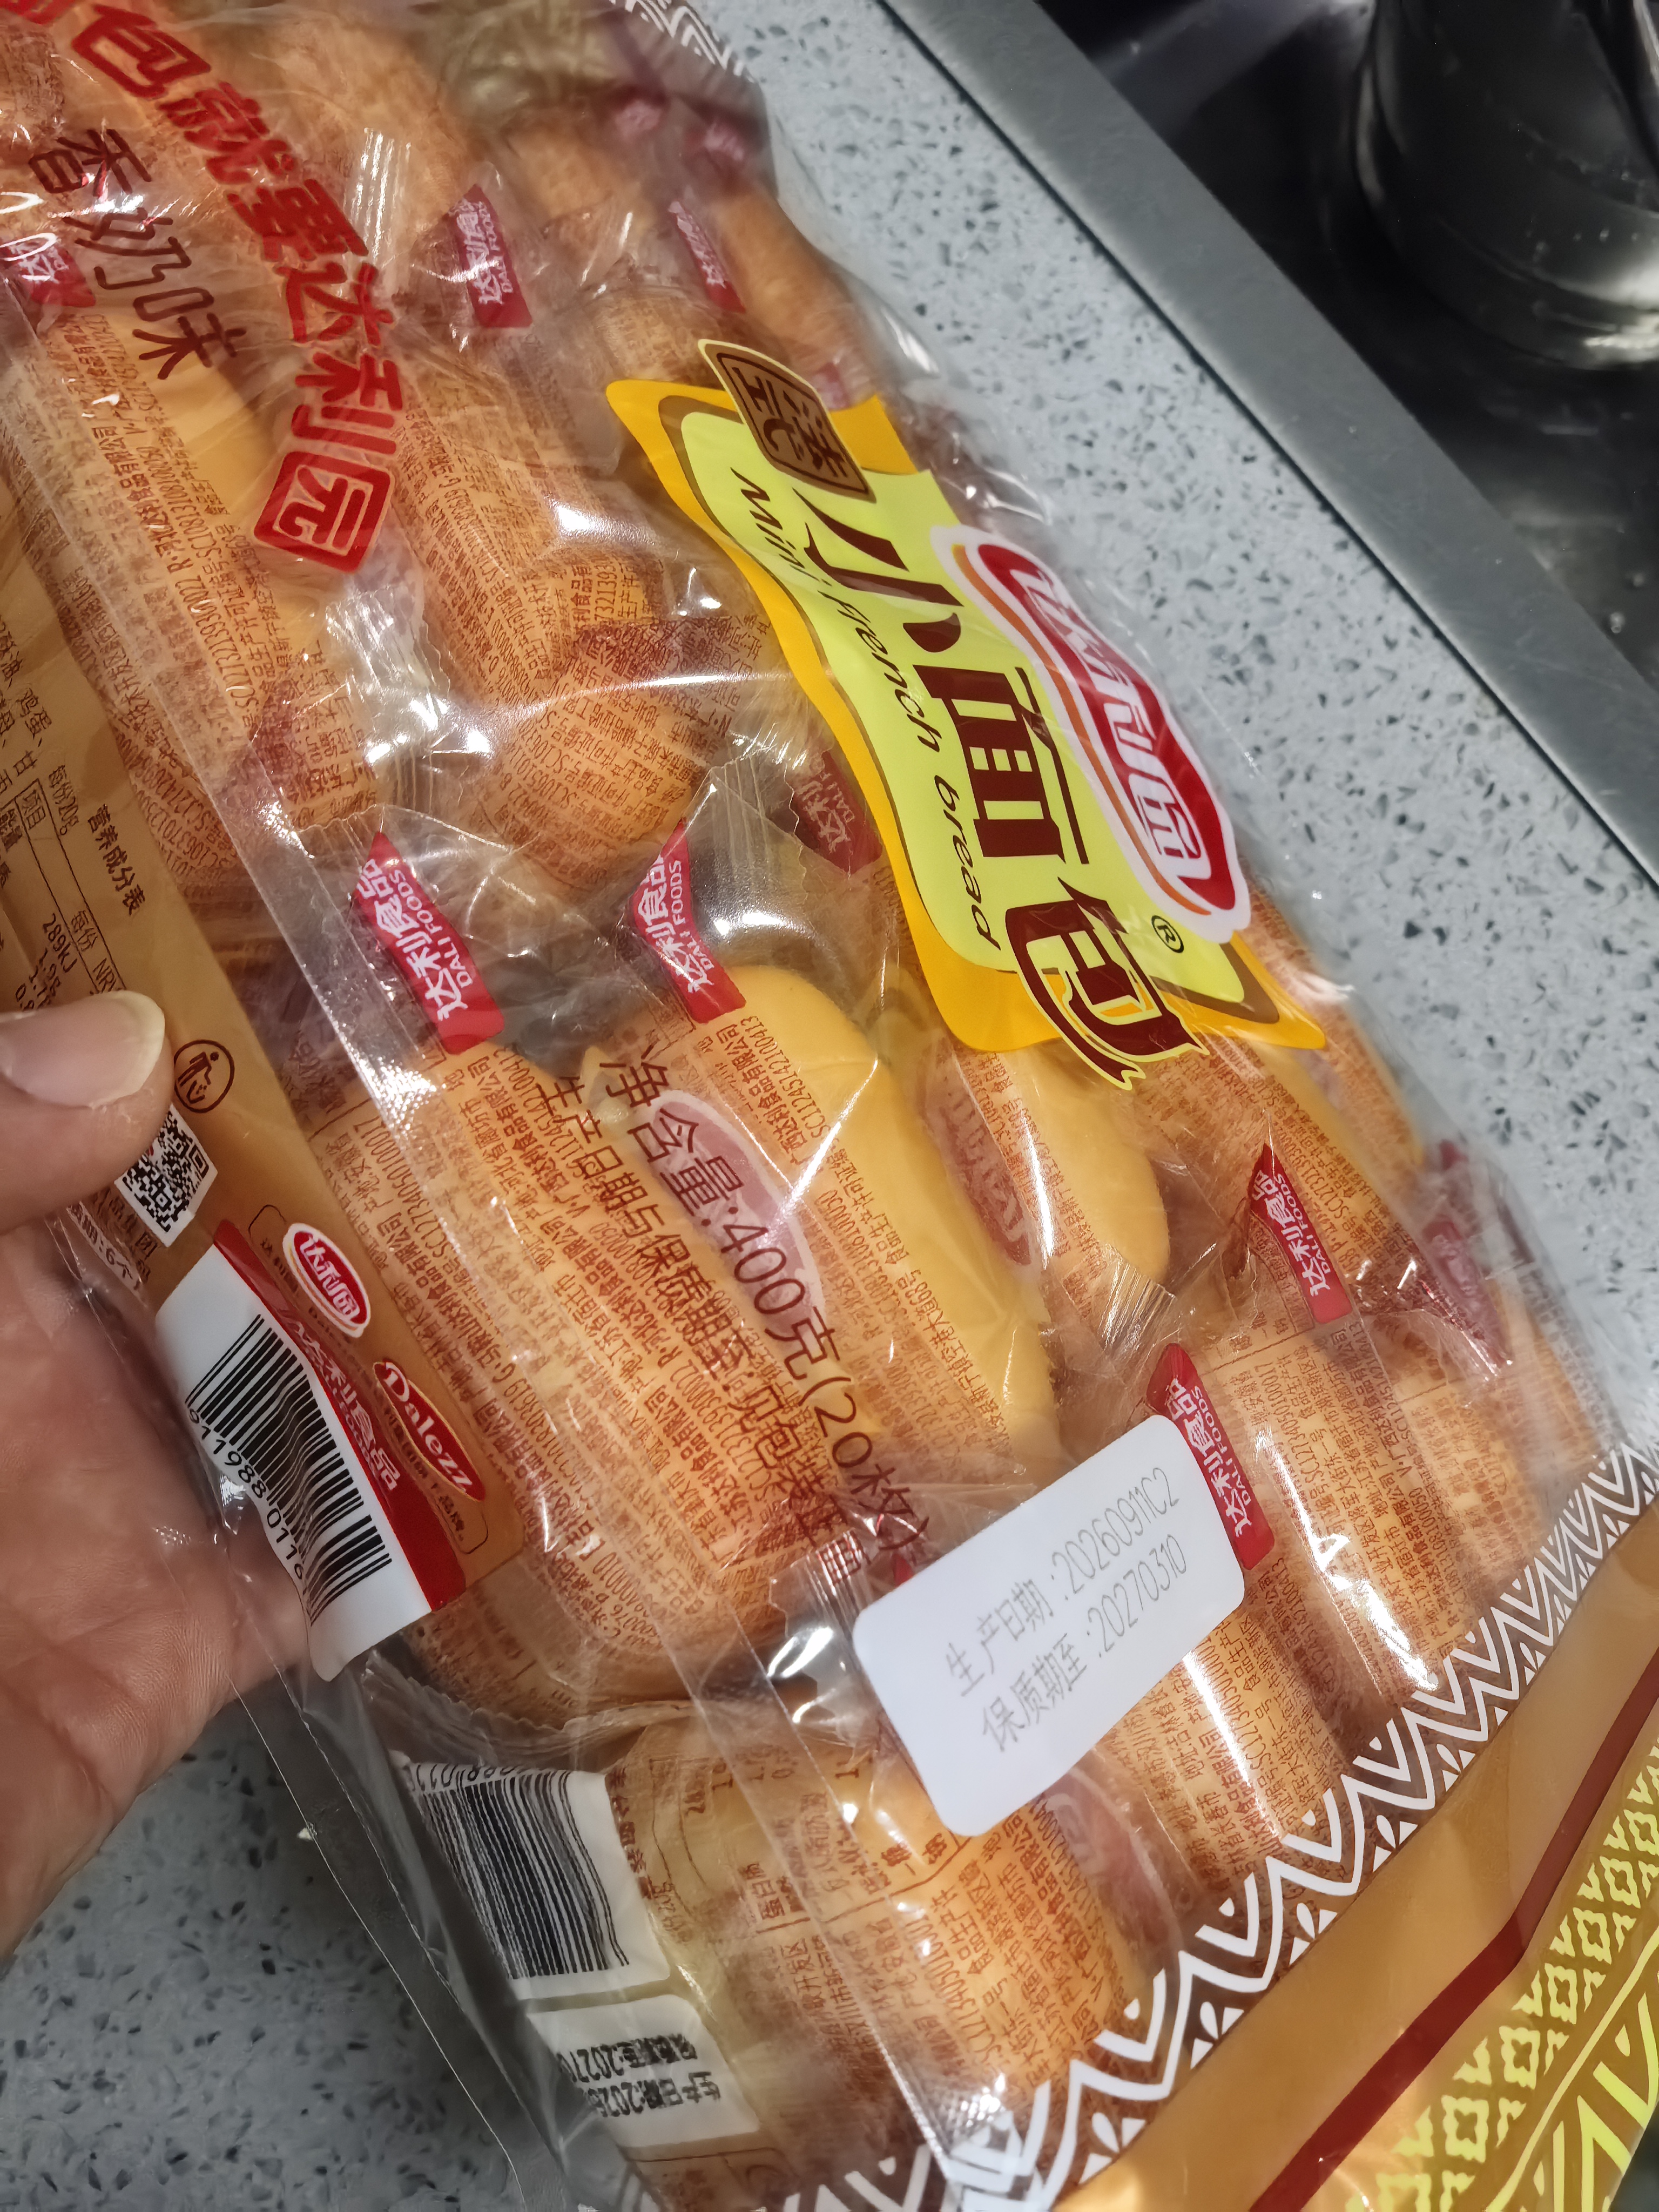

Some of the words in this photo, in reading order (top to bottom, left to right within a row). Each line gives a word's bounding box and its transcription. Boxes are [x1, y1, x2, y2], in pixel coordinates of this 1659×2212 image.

[28, 127, 247, 380] 香奶味
[730, 466, 833, 588] Mini
[934, 774, 1002, 952] bread
[1009, 567, 1213, 881] 达利园
[17, 792, 46, 831] 项目
[791, 484, 1205, 1087] 小面包
[86, 803, 146, 917] 营养成分表
[388, 867, 442, 935] FOODS
[666, 857, 686, 926] FOODS
[71, 909, 99, 952] 每份
[356, 859, 468, 1021] 达利食品
[436, 934, 474, 989] DALI
[680, 927, 715, 972] DALI
[1272, 1171, 1309, 1231] FOODS
[300, 1234, 360, 1328] 达利园
[537, 1211, 684, 1370] R·河北达利食品有限公司
[1305, 1232, 1332, 1274] DALI
[598, 1044, 929, 1552] 净含量:400克(20枚)
[384, 1362, 473, 1489] Dalezz
[1188, 1384, 1228, 1455] FOODS
[1223, 1457, 1253, 1506] DALI
